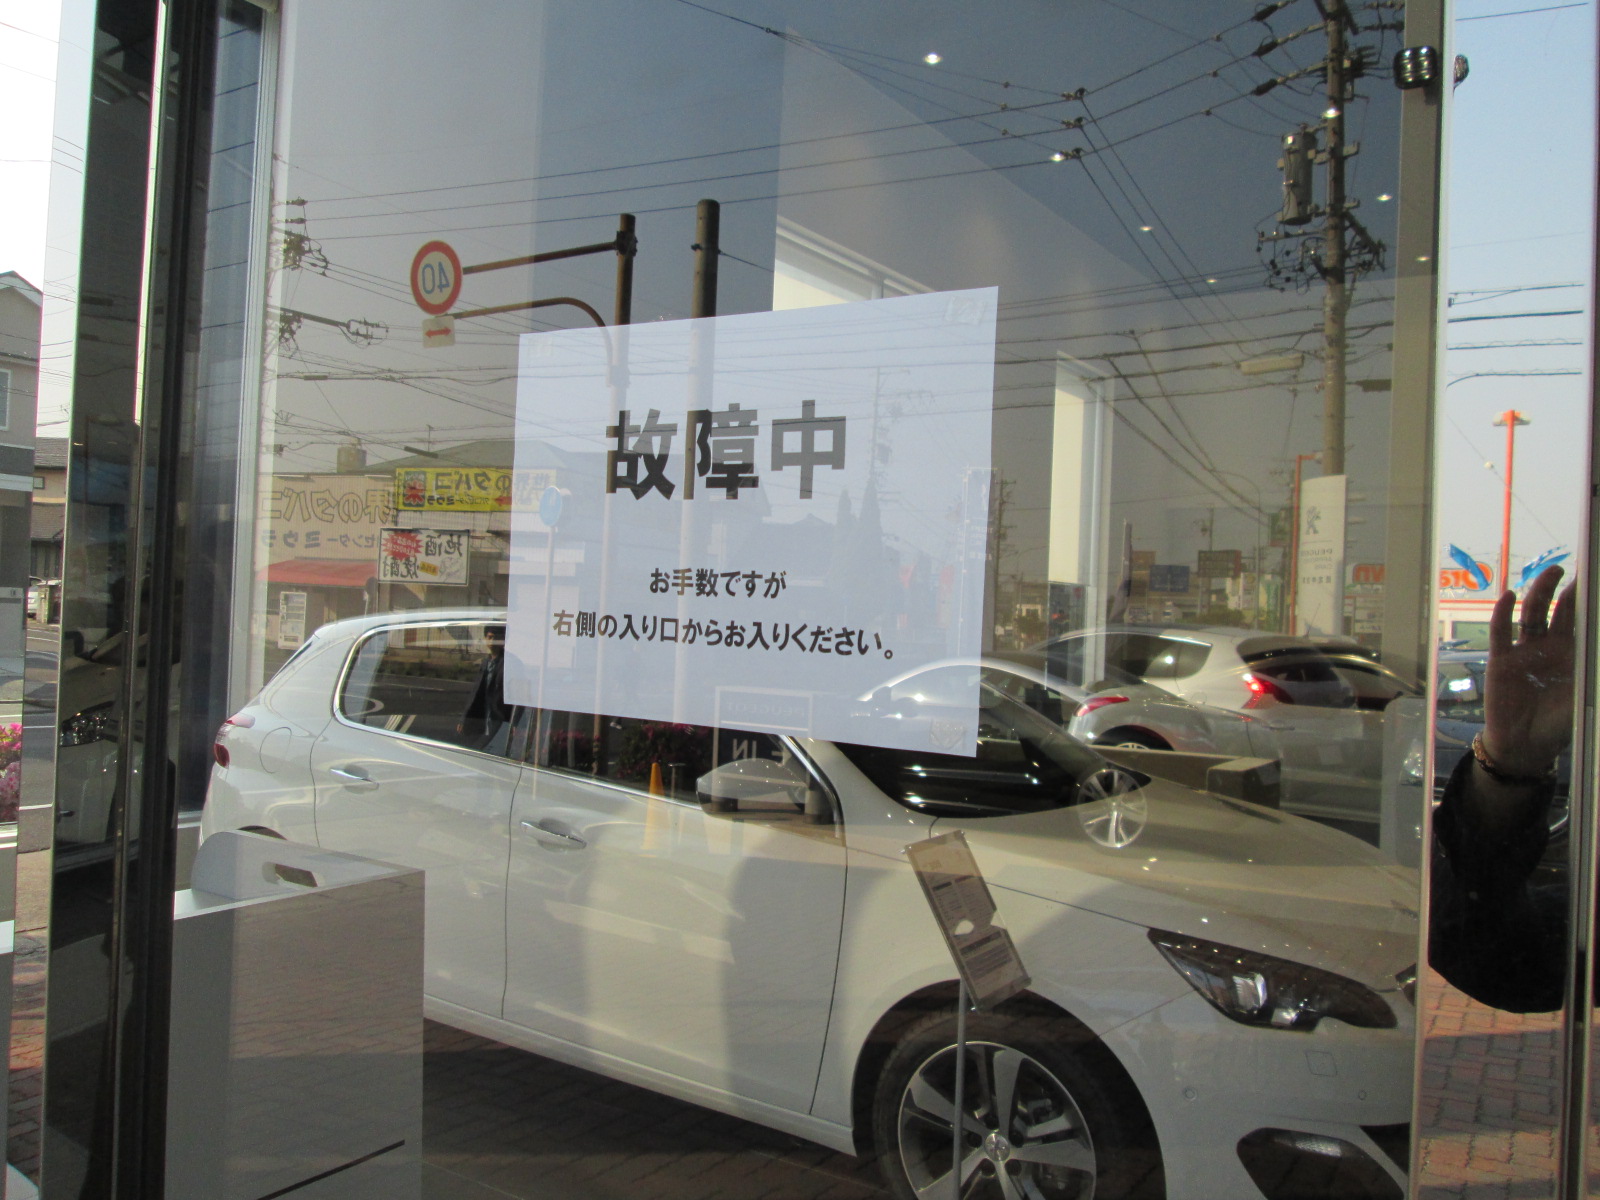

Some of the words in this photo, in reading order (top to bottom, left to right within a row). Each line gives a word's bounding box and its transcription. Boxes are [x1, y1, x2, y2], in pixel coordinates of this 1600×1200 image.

[606, 400, 846, 500] 故障中
[649, 568, 787, 599] お手数ですが
[553, 610, 893, 660] 右側の入り口からお入りください。
